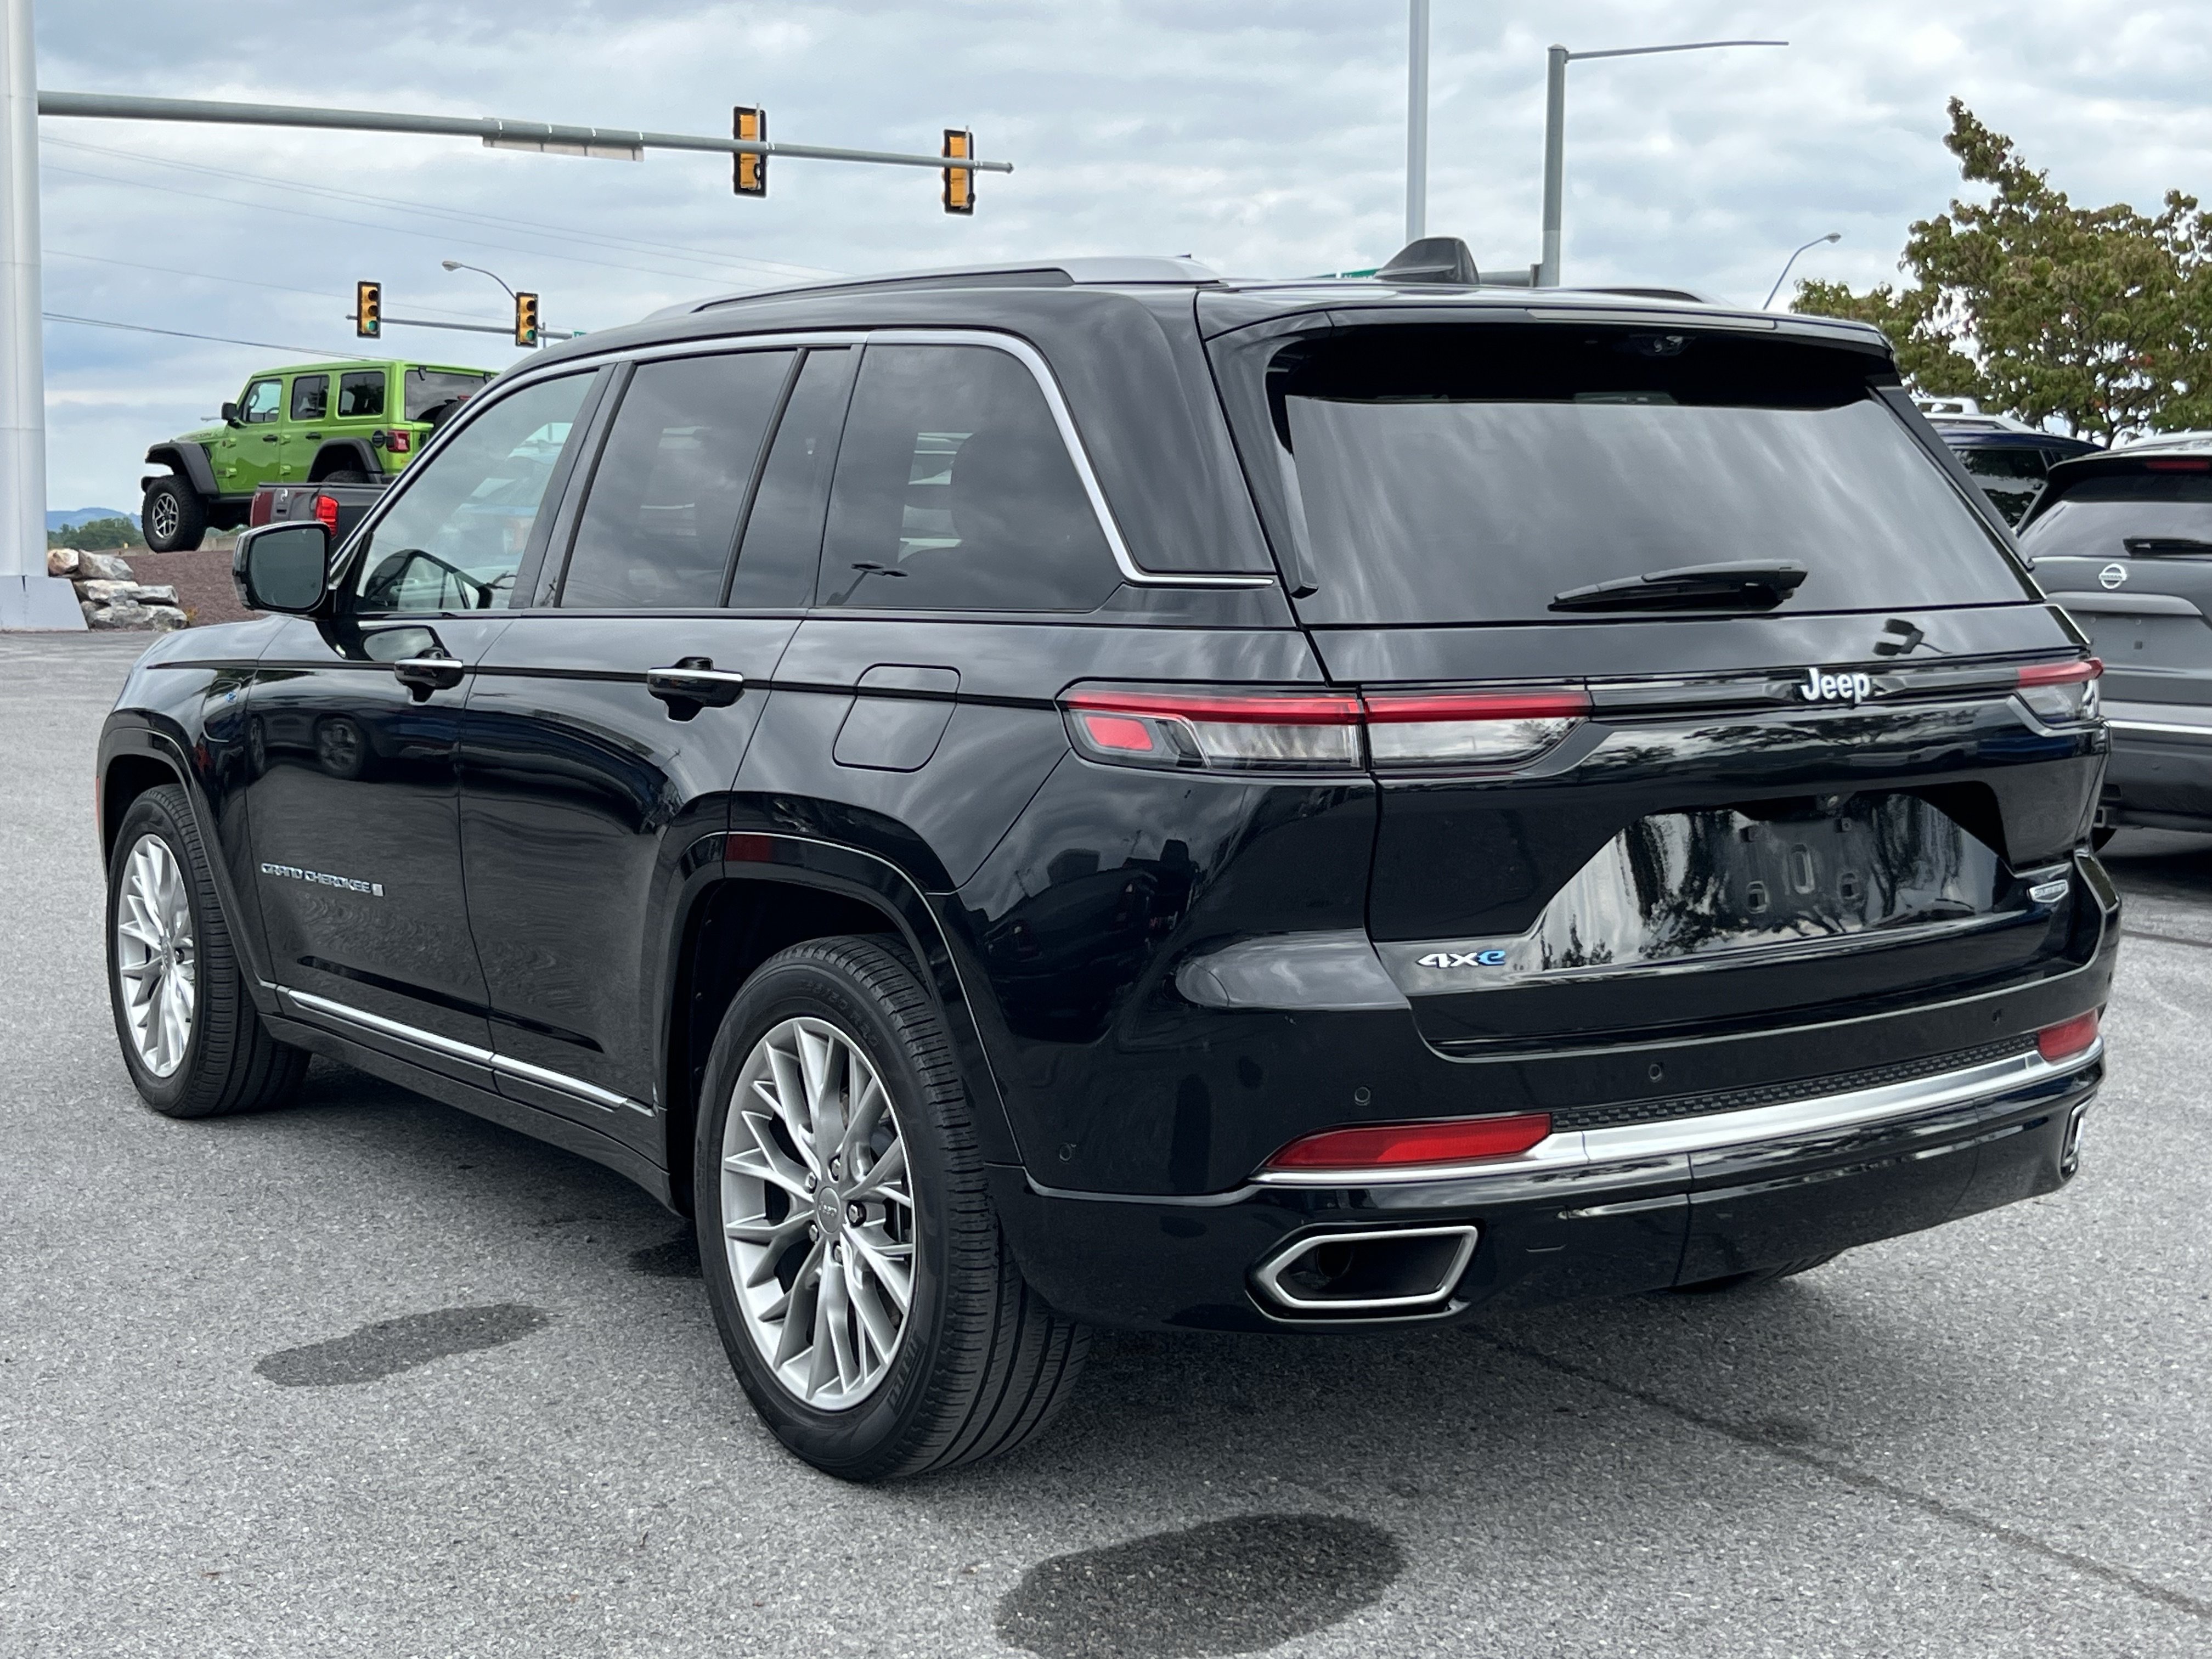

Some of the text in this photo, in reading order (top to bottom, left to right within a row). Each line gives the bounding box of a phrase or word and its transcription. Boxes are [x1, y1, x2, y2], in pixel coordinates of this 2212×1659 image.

[1801, 668, 1870, 703] Jeep
[261, 863, 372, 893] GRAND CHEROKEE
